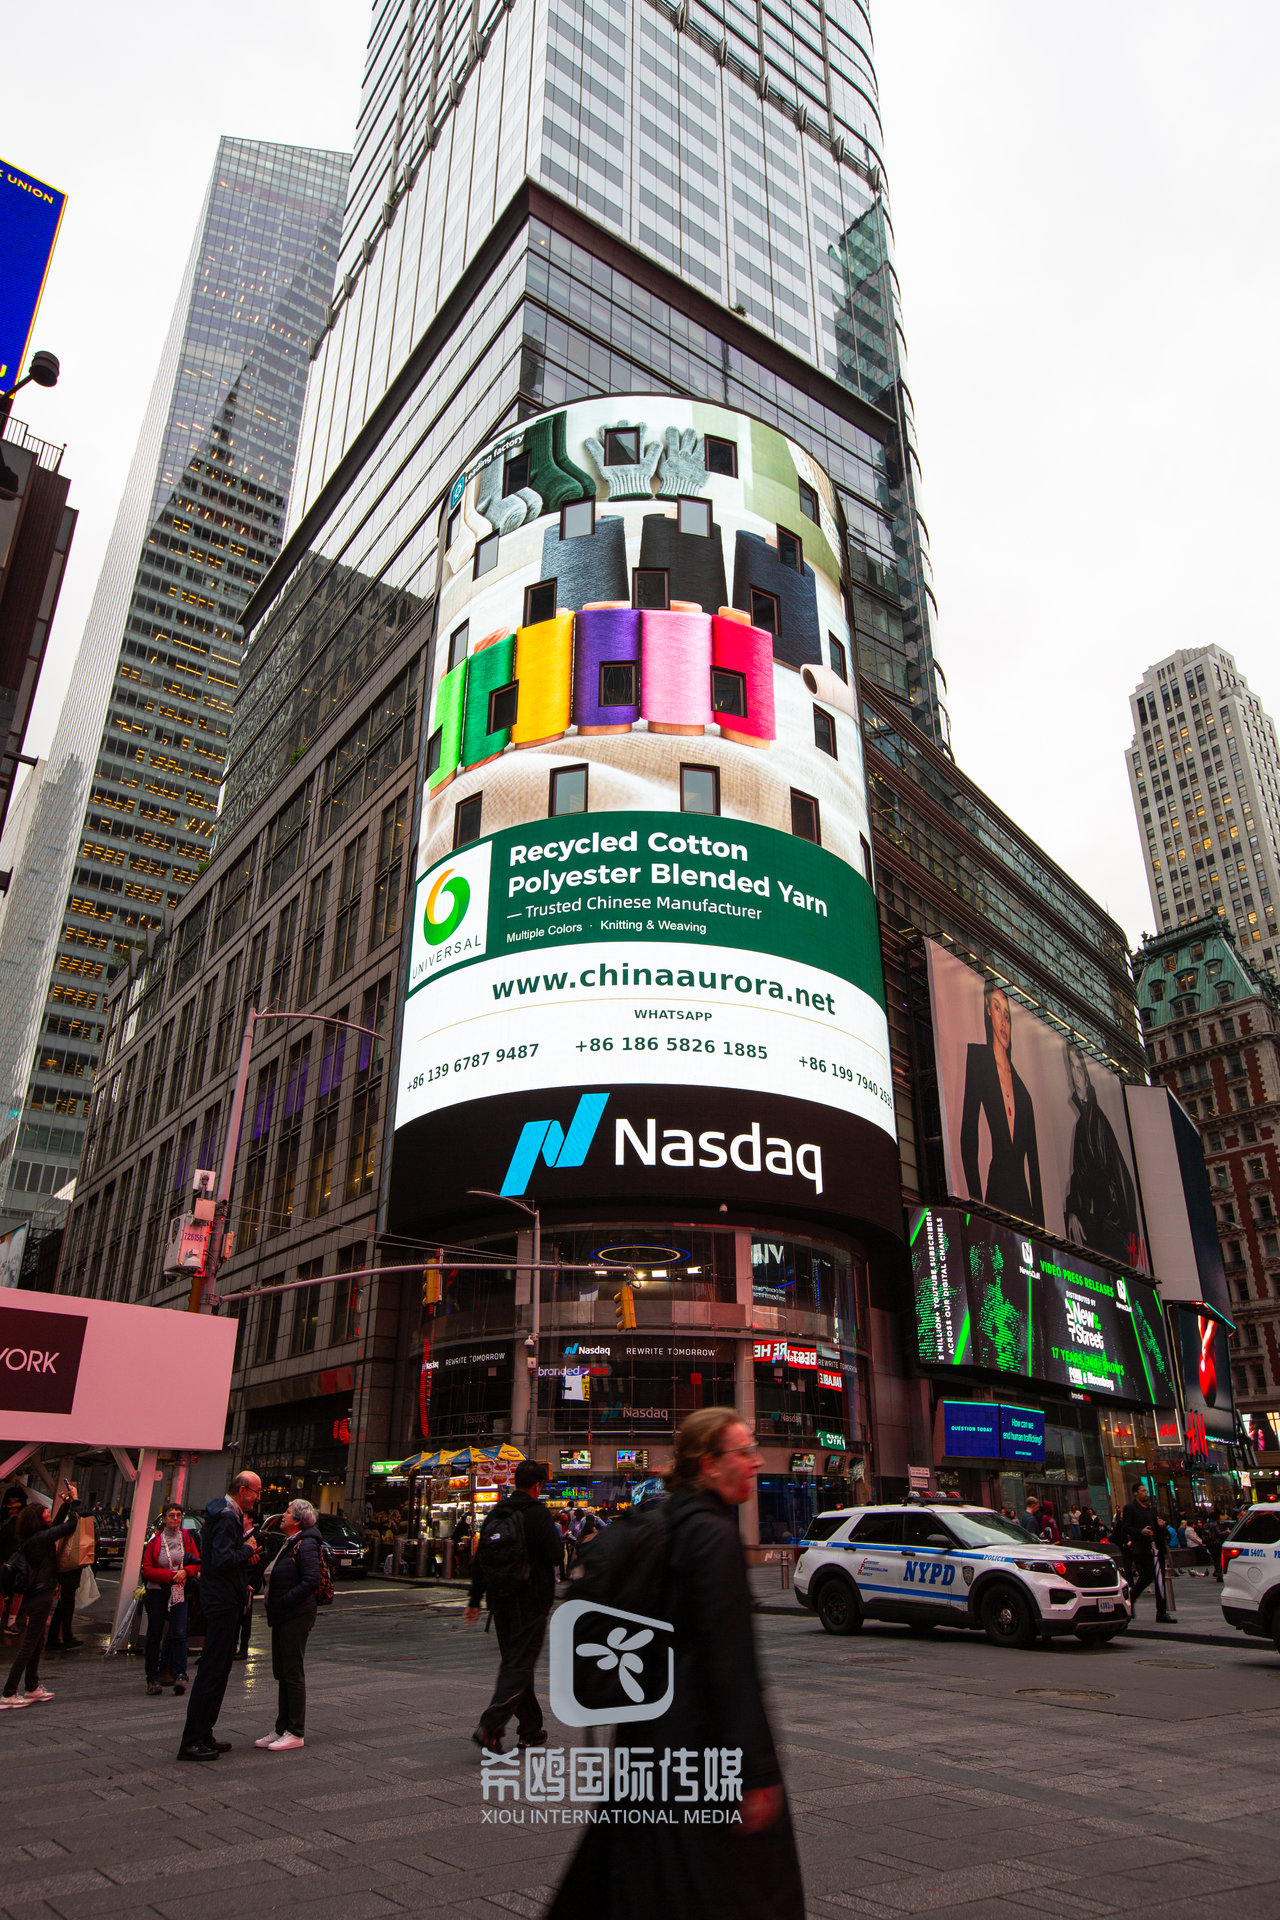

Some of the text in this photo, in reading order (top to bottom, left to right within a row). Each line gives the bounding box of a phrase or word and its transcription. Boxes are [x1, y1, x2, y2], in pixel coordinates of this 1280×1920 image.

[7, 173, 53, 204] UNION
[493, 434, 524, 458] factory
[509, 831, 748, 867] Recycled Cotton
[508, 863, 828, 917] Polyester Blended Yarn
[525, 897, 582, 919] Trusted
[586, 896, 651, 911] Chinese
[656, 896, 762, 920] Manufacturer
[506, 919, 707, 944] Multiple Colors Knitting & Weaving
[412, 935, 482, 980] UNIVERSAL
[492, 962, 836, 1016] www.chinaaurora.net
[634, 1009, 713, 1022] WHATSAPP
[575, 1037, 768, 1060] +86 186 5826 1885
[407, 1043, 540, 1093] +86 139 6787 9487
[799, 1056, 827, 1073] +86
[831, 1063, 853, 1082] 199
[856, 1073, 878, 1096] 7940
[615, 1118, 824, 1195] Nasdaq
[926, 1211, 937, 1267] SUBSCRIBERS
[930, 1269, 940, 1309] YOUTUBE
[937, 1217, 955, 1355] ACROSS OUR DIGITAL CHANNELS
[1040, 1259, 1115, 1298] VIDEO PRESS RELEASES
[1072, 1300, 1095, 1329] New
[1075, 1323, 1105, 1350] Street
[469, 1352, 506, 1363] TOMORROW
[578, 1346, 716, 1357] Nasdaq REWRITE TOMORROW
[1051, 1346, 1059, 1360] 17
[623, 1406, 669, 1421] Nasdaq
[983, 1554, 1006, 1562] POLICE
[903, 1560, 955, 1586] NYPD
